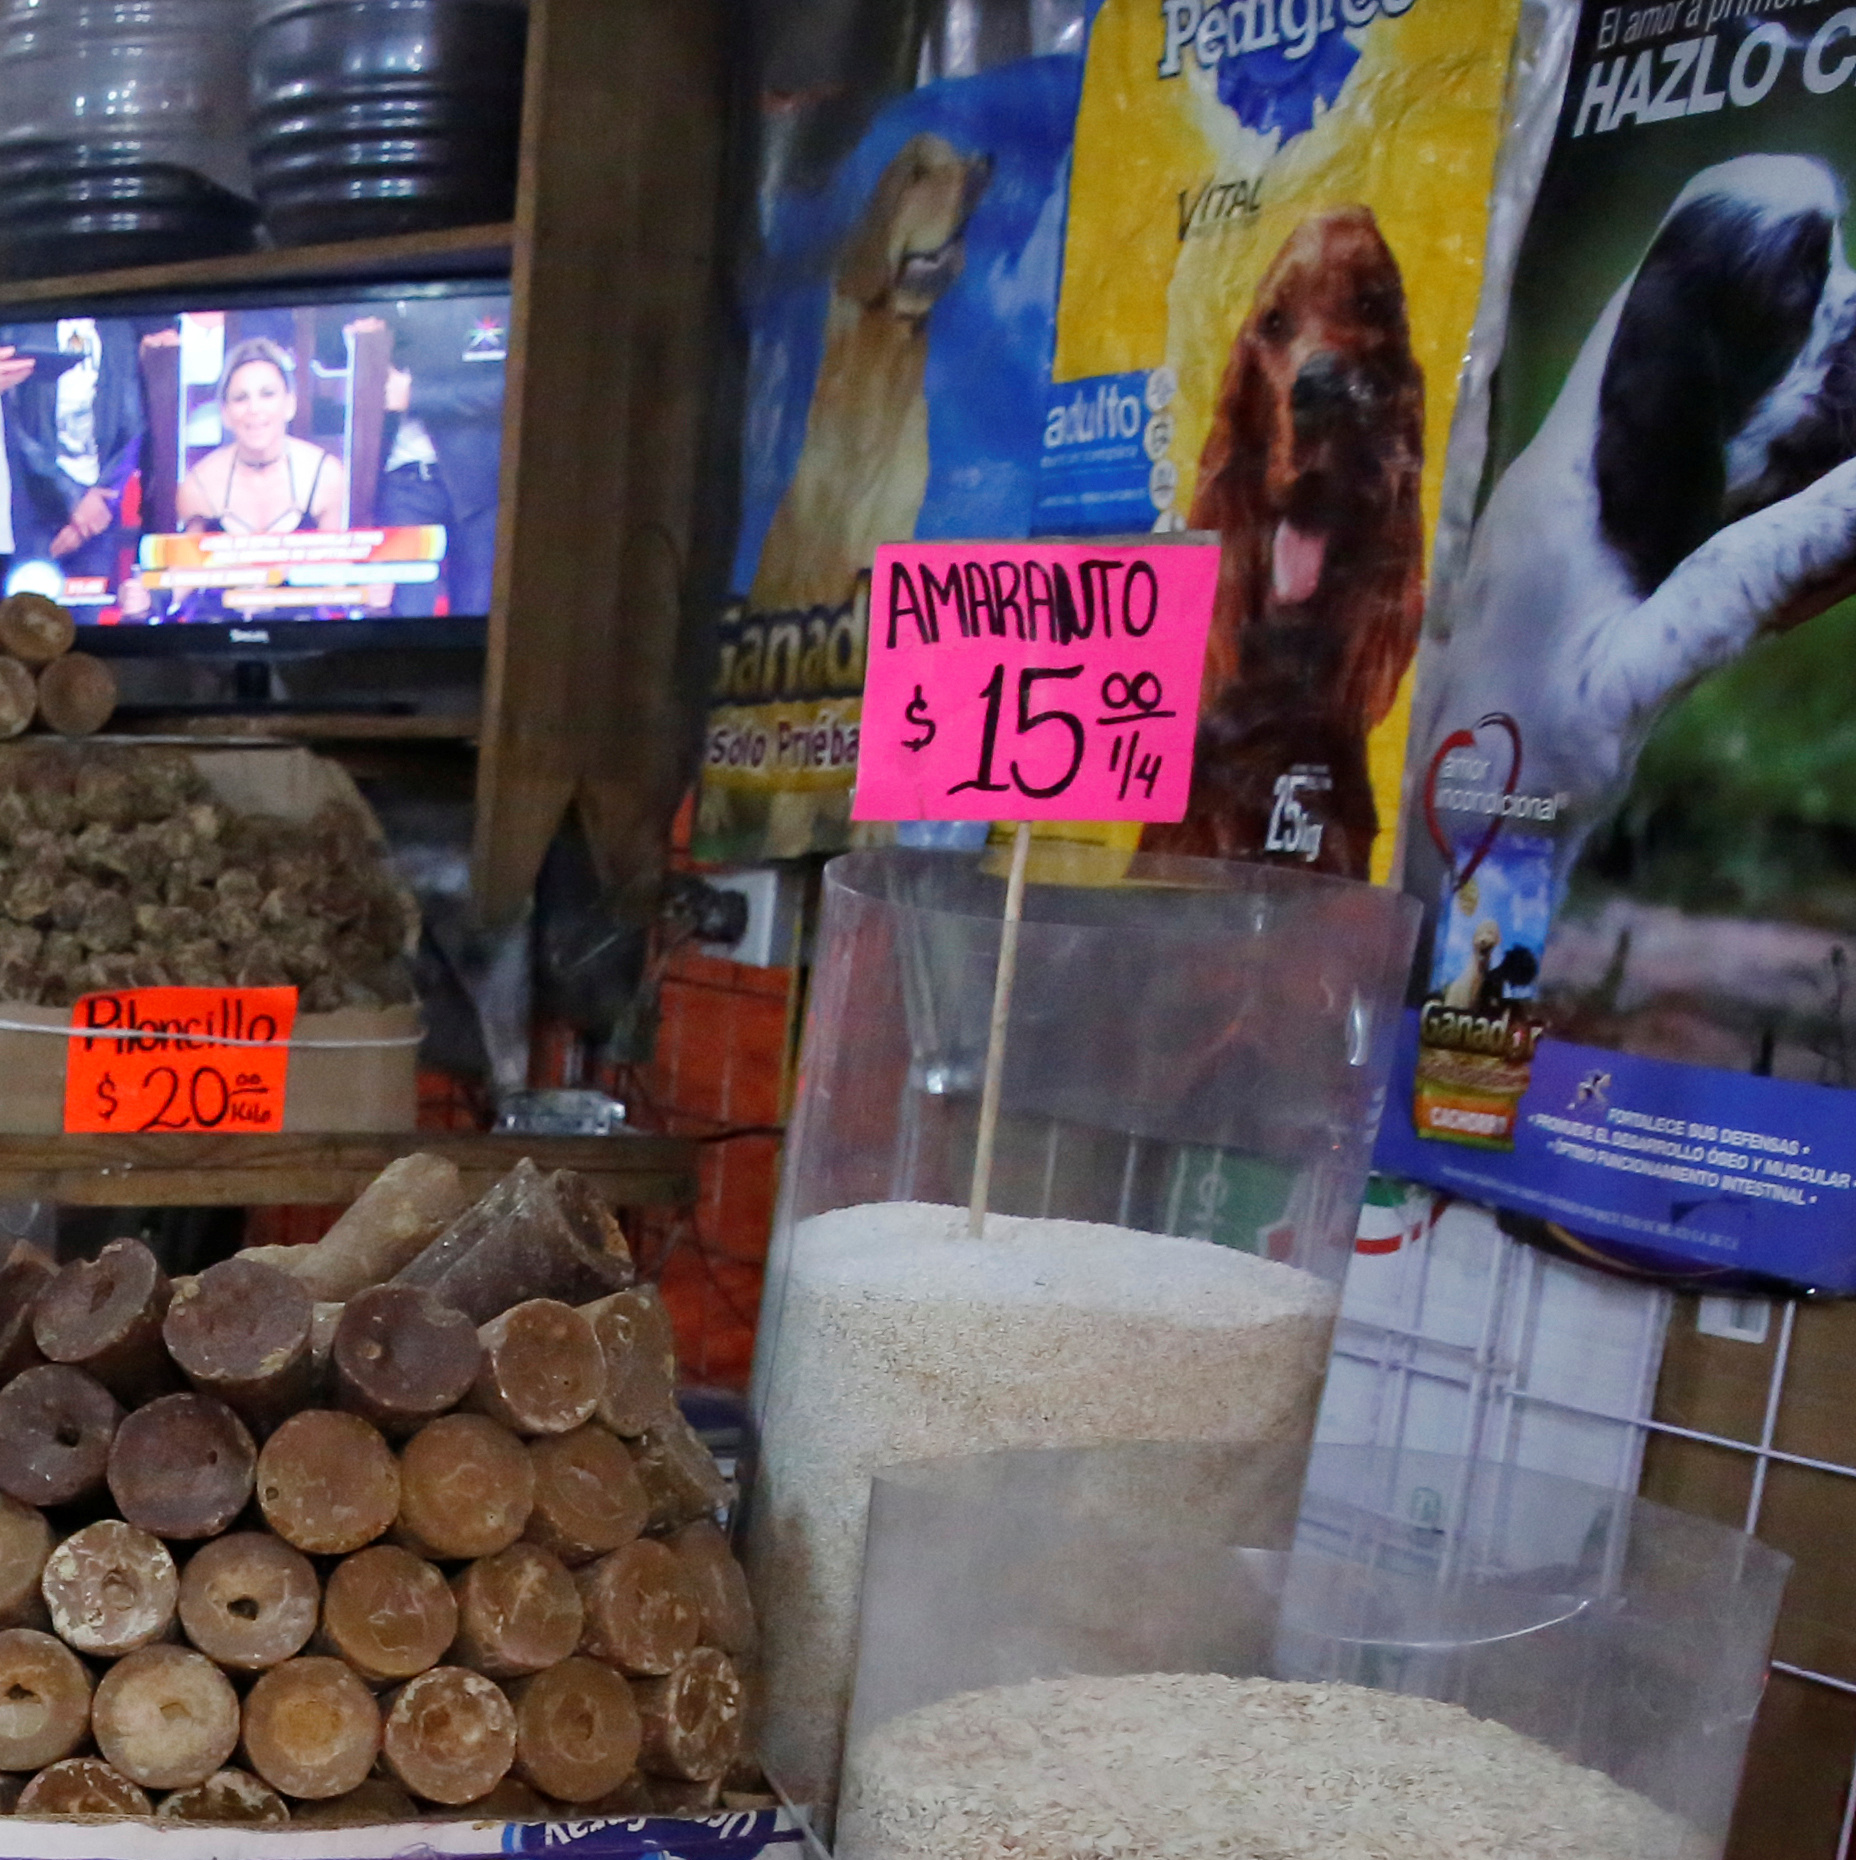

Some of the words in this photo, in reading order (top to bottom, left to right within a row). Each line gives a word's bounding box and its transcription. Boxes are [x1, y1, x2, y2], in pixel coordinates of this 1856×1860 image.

[1597, 7, 1620, 49] El
[1624, 1, 1681, 44] amor
[1572, 22, 1789, 138] HAZLO
[1178, 178, 1263, 241] VITAL
[886, 560, 1160, 649] AMARANTO
[901, 686, 937, 752] $
[948, 664, 1085, 797] 15
[1109, 733, 1162, 801] 1/4
[98, 1077, 118, 1123] $
[140, 1066, 231, 1131] 20
